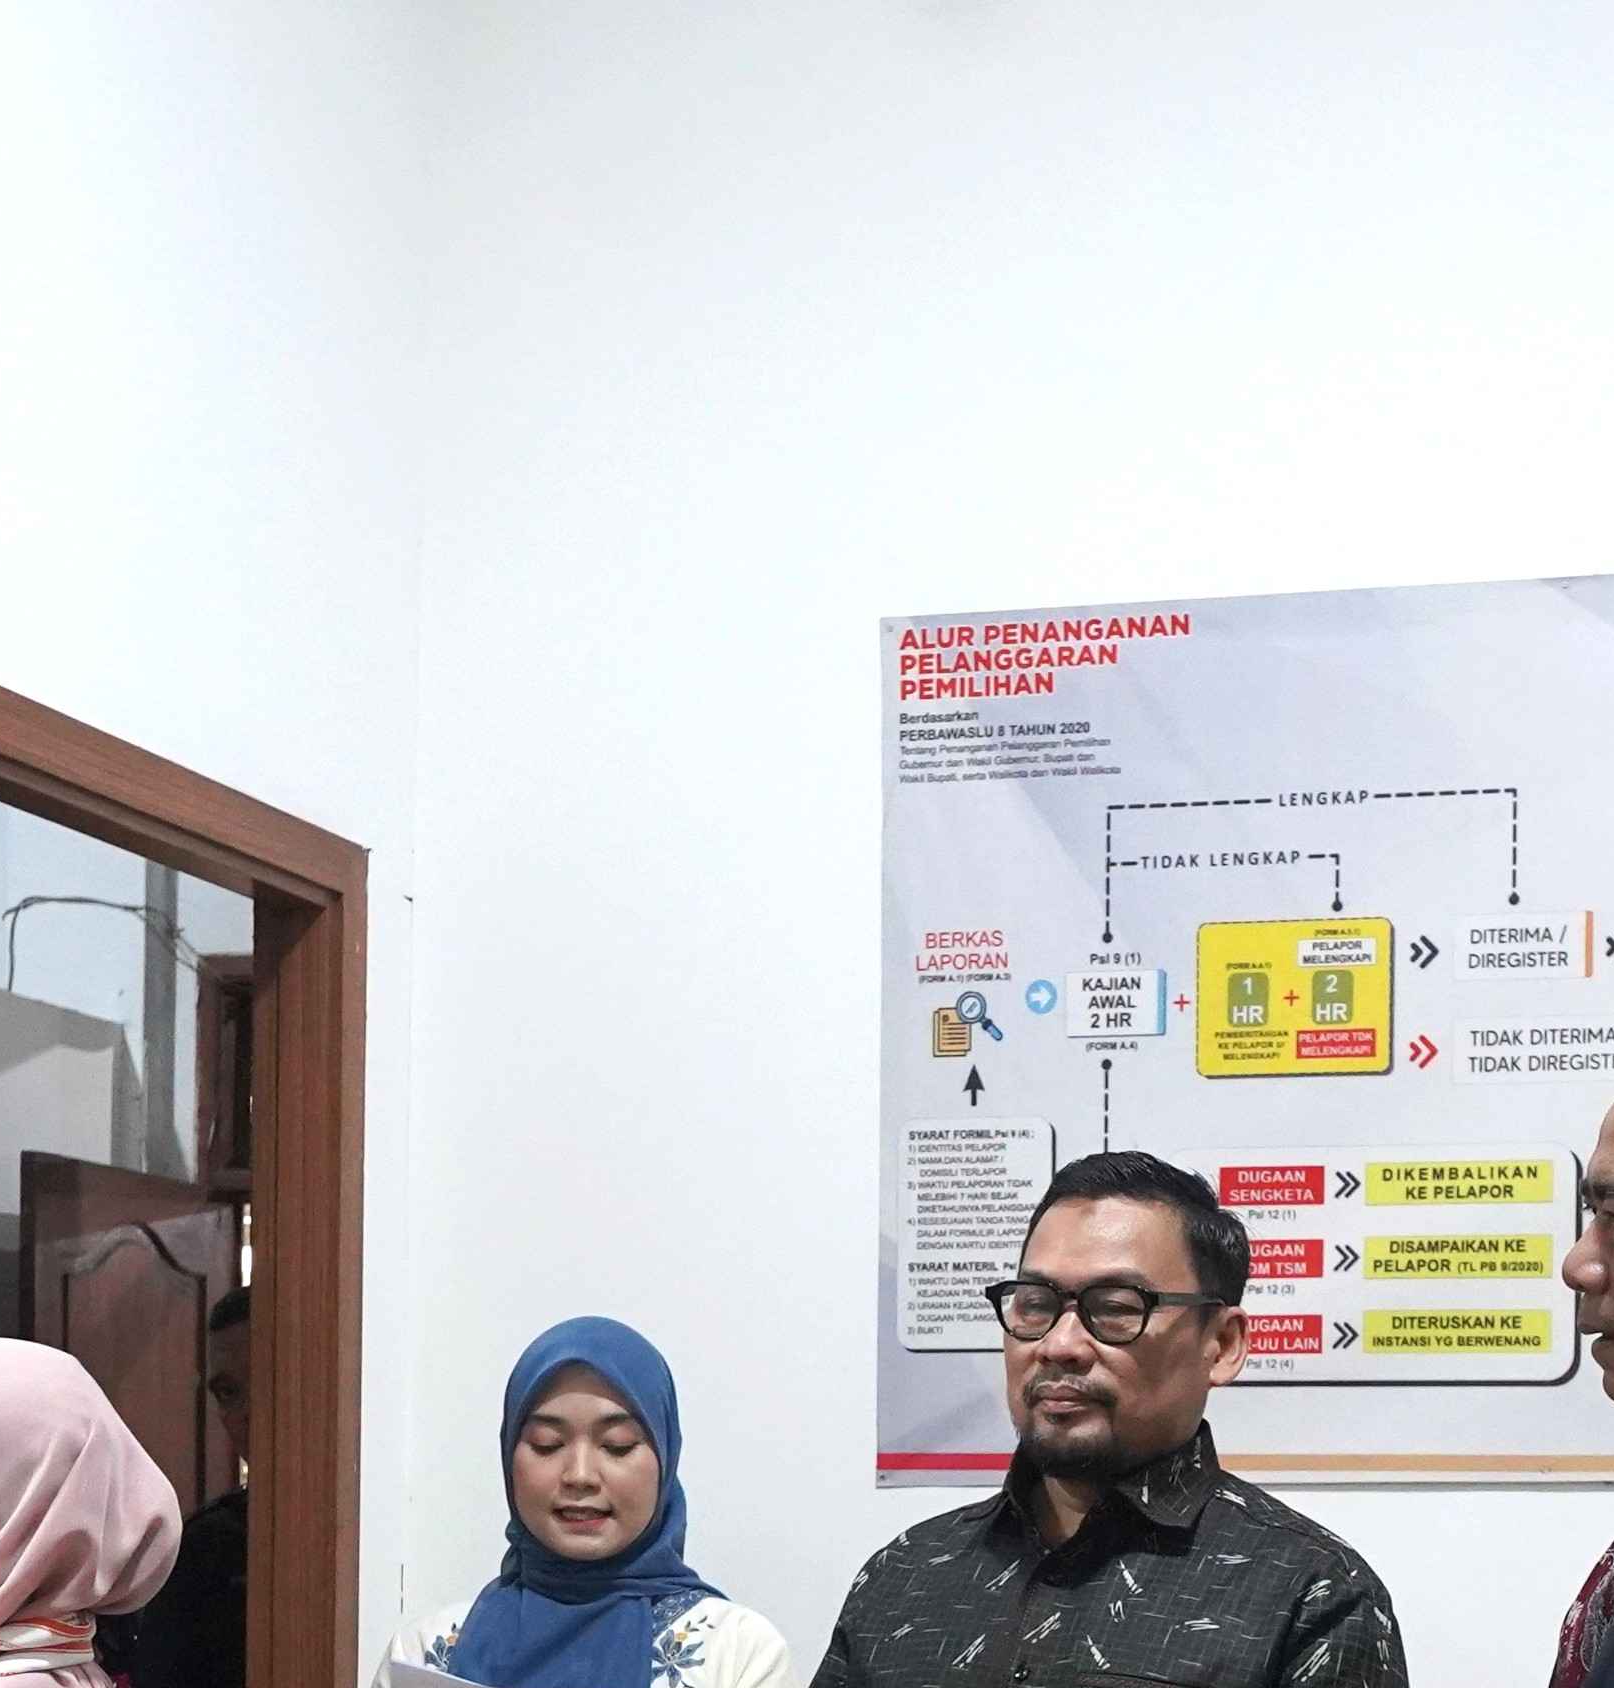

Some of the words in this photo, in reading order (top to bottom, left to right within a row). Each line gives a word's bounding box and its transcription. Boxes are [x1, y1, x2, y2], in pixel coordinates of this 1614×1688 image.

[900, 626, 974, 650] ALUR
[985, 614, 1191, 645] PENANGANAN
[900, 644, 1118, 676] PELANGGARAN
[900, 672, 1053, 700] PEMILIHAN
[899, 712, 978, 724] Berdasarkan
[899, 726, 994, 741] PERBAWASLU
[998, 726, 1005, 737] 8
[1009, 723, 1056, 737] TAHUN
[1059, 722, 1090, 734] 2020
[900, 745, 935, 756] Tentang
[939, 742, 998, 754] Penanganan
[899, 758, 942, 770] Gubernur
[945, 758, 963, 768] dan
[967, 756, 992, 767] Wakil
[1043, 753, 1073, 764] Bupati
[1077, 753, 1095, 762] dan
[899, 772, 925, 784] Wakil
[962, 771, 986, 781] serta
[989, 769, 1029, 780] Walikota
[1031, 768, 1049, 778] dan
[1279, 790, 1368, 807] LENGKAP
[1141, 854, 1199, 869] TIDAK
[1210, 850, 1301, 867] LENGKAP
[925, 930, 1003, 949] BERKAS
[1470, 928, 1553, 944] DITERIMA
[1559, 924, 1568, 944] /
[1313, 940, 1362, 951] PELAPOR
[916, 952, 1009, 971] LAPORAN
[1090, 953, 1110, 965] Psl
[1115, 953, 1121, 964] 9
[1125, 952, 1142, 966] (1)
[1303, 954, 1372, 964] MELENGKAPI
[1469, 952, 1568, 969] DIREGISTER
[919, 974, 948, 984] (FORM
[966, 972, 994, 982] (FORM
[1082, 977, 1141, 992] KAJIAN
[1326, 974, 1338, 993] 2
[1243, 977, 1253, 995] 1
[1089, 995, 1137, 1010] AWAL
[1233, 1005, 1264, 1024] HR
[1316, 1003, 1348, 1021] HR
[1091, 1014, 1100, 1028] 2
[1107, 1013, 1132, 1028] HR
[1299, 1032, 1350, 1043] PELAPOR
[1351, 1031, 1373, 1042] TDK
[1470, 1030, 1523, 1047] TIDAK
[1086, 1042, 1119, 1052] (FORM
[1218, 1042, 1231, 1050] KE
[1233, 1041, 1274, 1049] PELAPOR
[1301, 1046, 1371, 1056] MELENGKAPI
[1469, 1055, 1521, 1073] TIDAK
[909, 1130, 950, 1140] SYARAT
[953, 1130, 993, 1140] FORMIL
[919, 1144, 962, 1152] IDENTITAS
[965, 1144, 1007, 1152] PELAPOR
[1238, 1171, 1305, 1184] DUGAAN
[1383, 1166, 1538, 1182] DIKEMBALIKAN
[1229, 1189, 1314, 1202] SENGKETA
[1406, 1186, 1428, 1200] KE
[1433, 1185, 1514, 1199] PELAPOR
[1249, 1210, 1264, 1220] Psl
[1268, 1210, 1280, 1220] 12
[1283, 1209, 1296, 1220] (1)
[1250, 1244, 1305, 1257] UGAAN
[1389, 1240, 1499, 1254] DISAMPAIKAN
[1505, 1240, 1526, 1252] KE
[909, 1262, 949, 1272] SYARAT
[953, 1262, 998, 1271] MATERIL
[1276, 1262, 1306, 1275] TSM
[1373, 1260, 1451, 1273] PELAPOR
[1457, 1262, 1475, 1273] (TL
[1480, 1262, 1497, 1271] PB
[1501, 1262, 1544, 1273] 9/2020)
[1248, 1286, 1262, 1295] Psl
[1267, 1286, 1278, 1295] 12
[1281, 1285, 1295, 1295] (3)
[1249, 1320, 1304, 1332] UGAAN
[1392, 1316, 1495, 1330] DITERUSKAN
[1501, 1316, 1522, 1329] KE
[1284, 1338, 1319, 1350] LAIN
[1373, 1336, 1430, 1347] INSTANSI
[1435, 1336, 1453, 1346] YG
[1457, 1336, 1541, 1346] BERWENANG
[1247, 1359, 1262, 1369] Psl
[1265, 1360, 1277, 1369] 12
[1279, 1359, 1294, 1369] (4)
